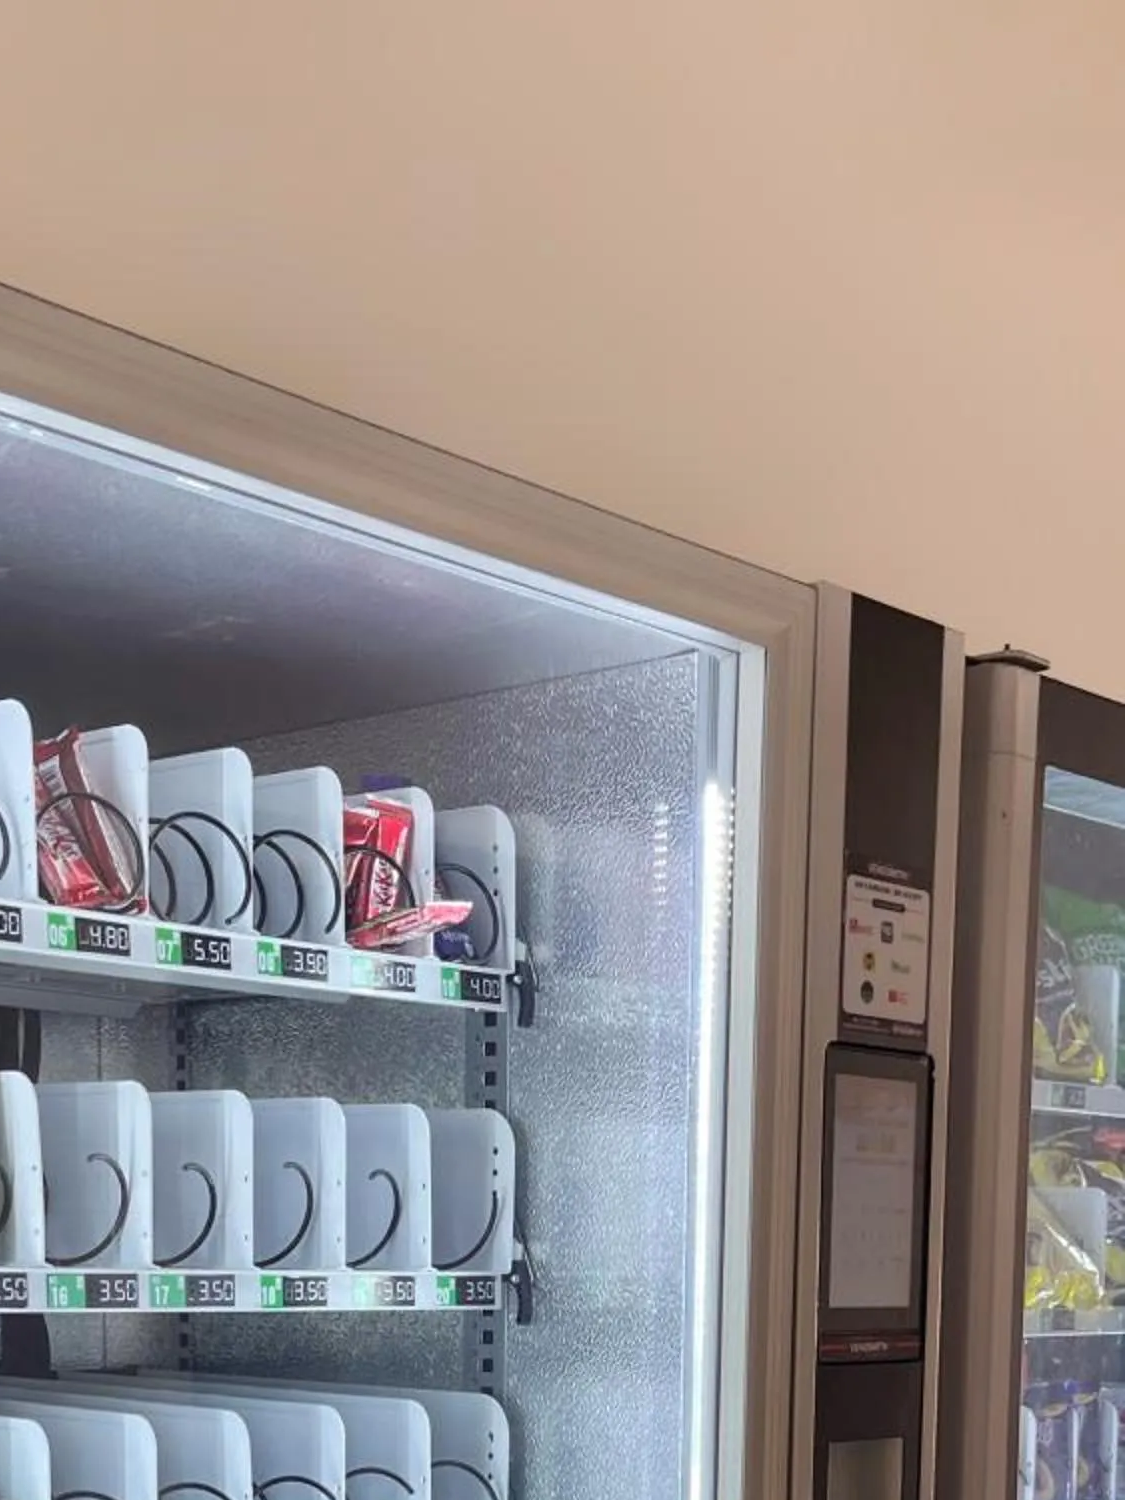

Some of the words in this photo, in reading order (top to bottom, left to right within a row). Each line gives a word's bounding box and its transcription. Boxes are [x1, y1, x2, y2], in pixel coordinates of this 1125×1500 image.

[194, 939, 231, 964] 5.50
[99, 1279, 138, 1302] 3.50
[154, 1285, 171, 1306] 17
[198, 1280, 234, 1302] 3.50
[466, 1281, 494, 1301] 3.50
